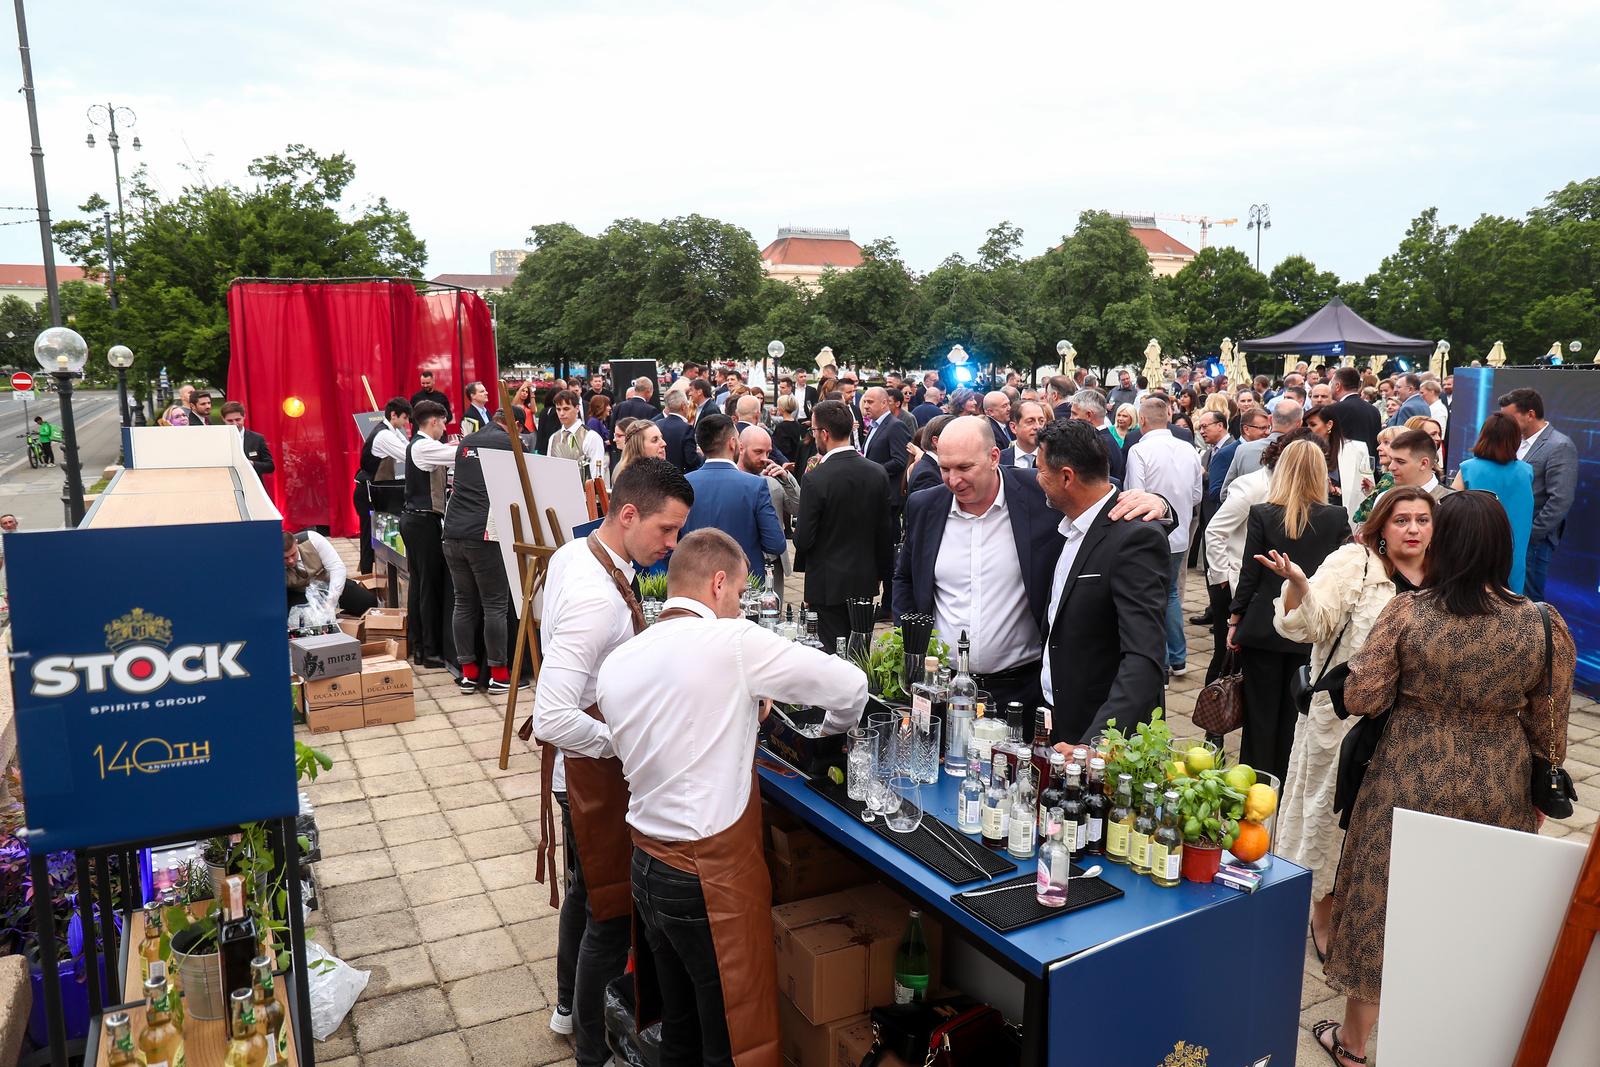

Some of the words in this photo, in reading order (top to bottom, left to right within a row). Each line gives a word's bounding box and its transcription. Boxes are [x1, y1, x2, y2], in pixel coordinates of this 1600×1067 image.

[327, 653, 357, 664] miraz
[31, 642, 249, 697] STOCK
[90, 701, 150, 715] SPIRITS
[155, 696, 206, 708] GROUP
[147, 758, 211, 770] ANNIVERSARY
